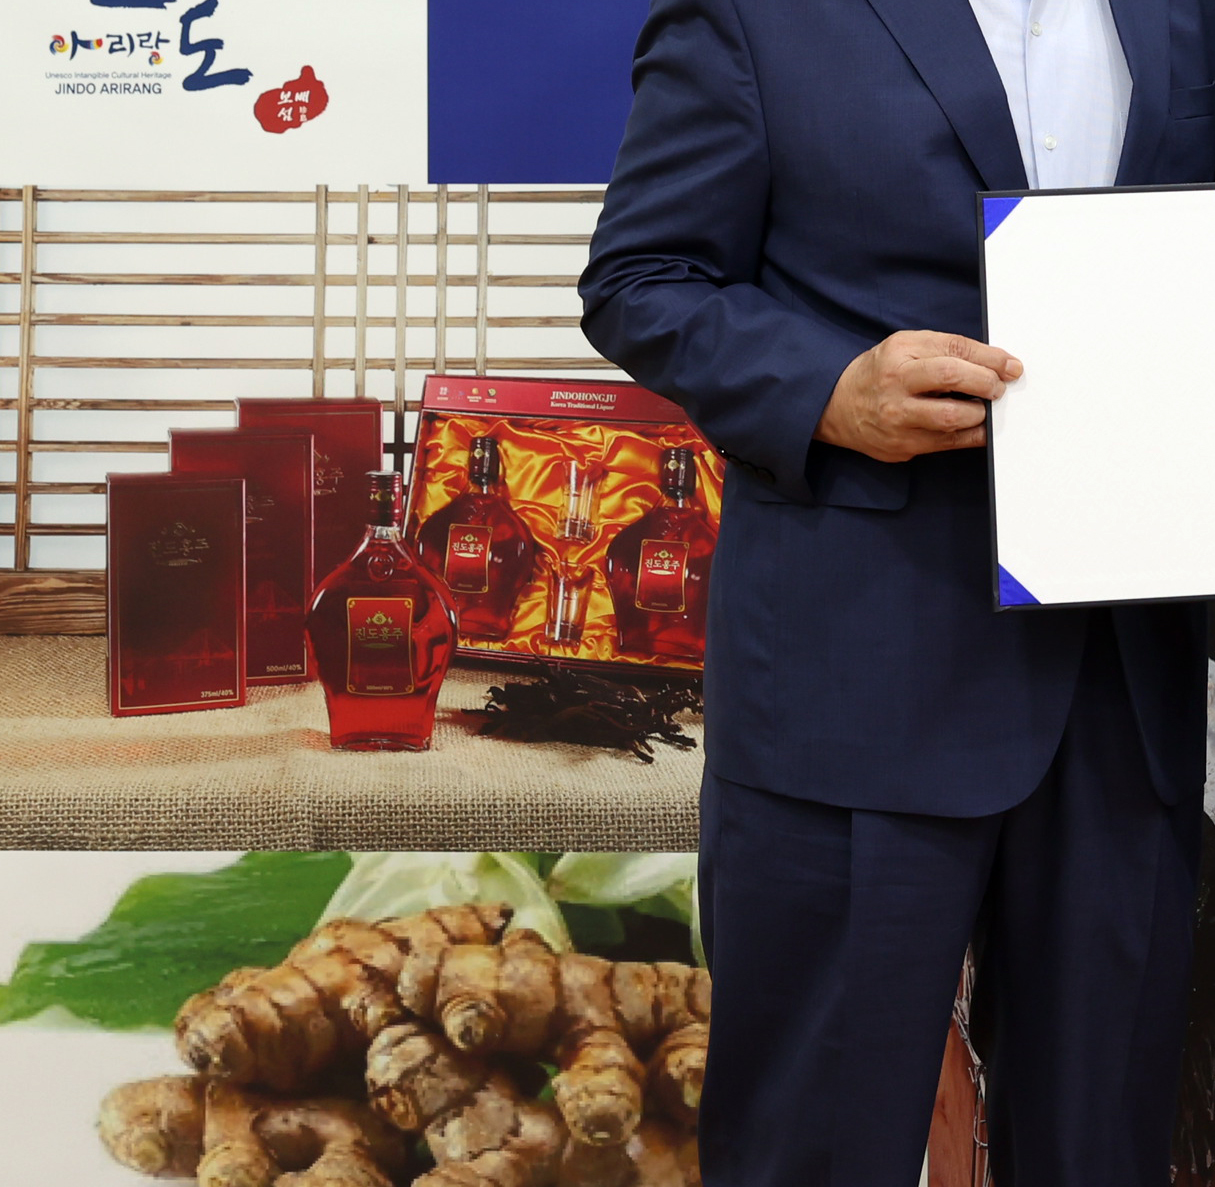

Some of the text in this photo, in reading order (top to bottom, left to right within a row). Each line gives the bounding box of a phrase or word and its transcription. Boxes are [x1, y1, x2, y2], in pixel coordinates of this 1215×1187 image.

[49, 30, 171, 67] 아리랑
[45, 71, 172, 80] Unesco Intangible Cultural Heritage
[55, 83, 162, 94] JINDO ARIRANG
[550, 391, 617, 403] JINDOHONGJU
[355, 626, 403, 641] 진도홍주
[200, 689, 234, 699] 375ml/40%
